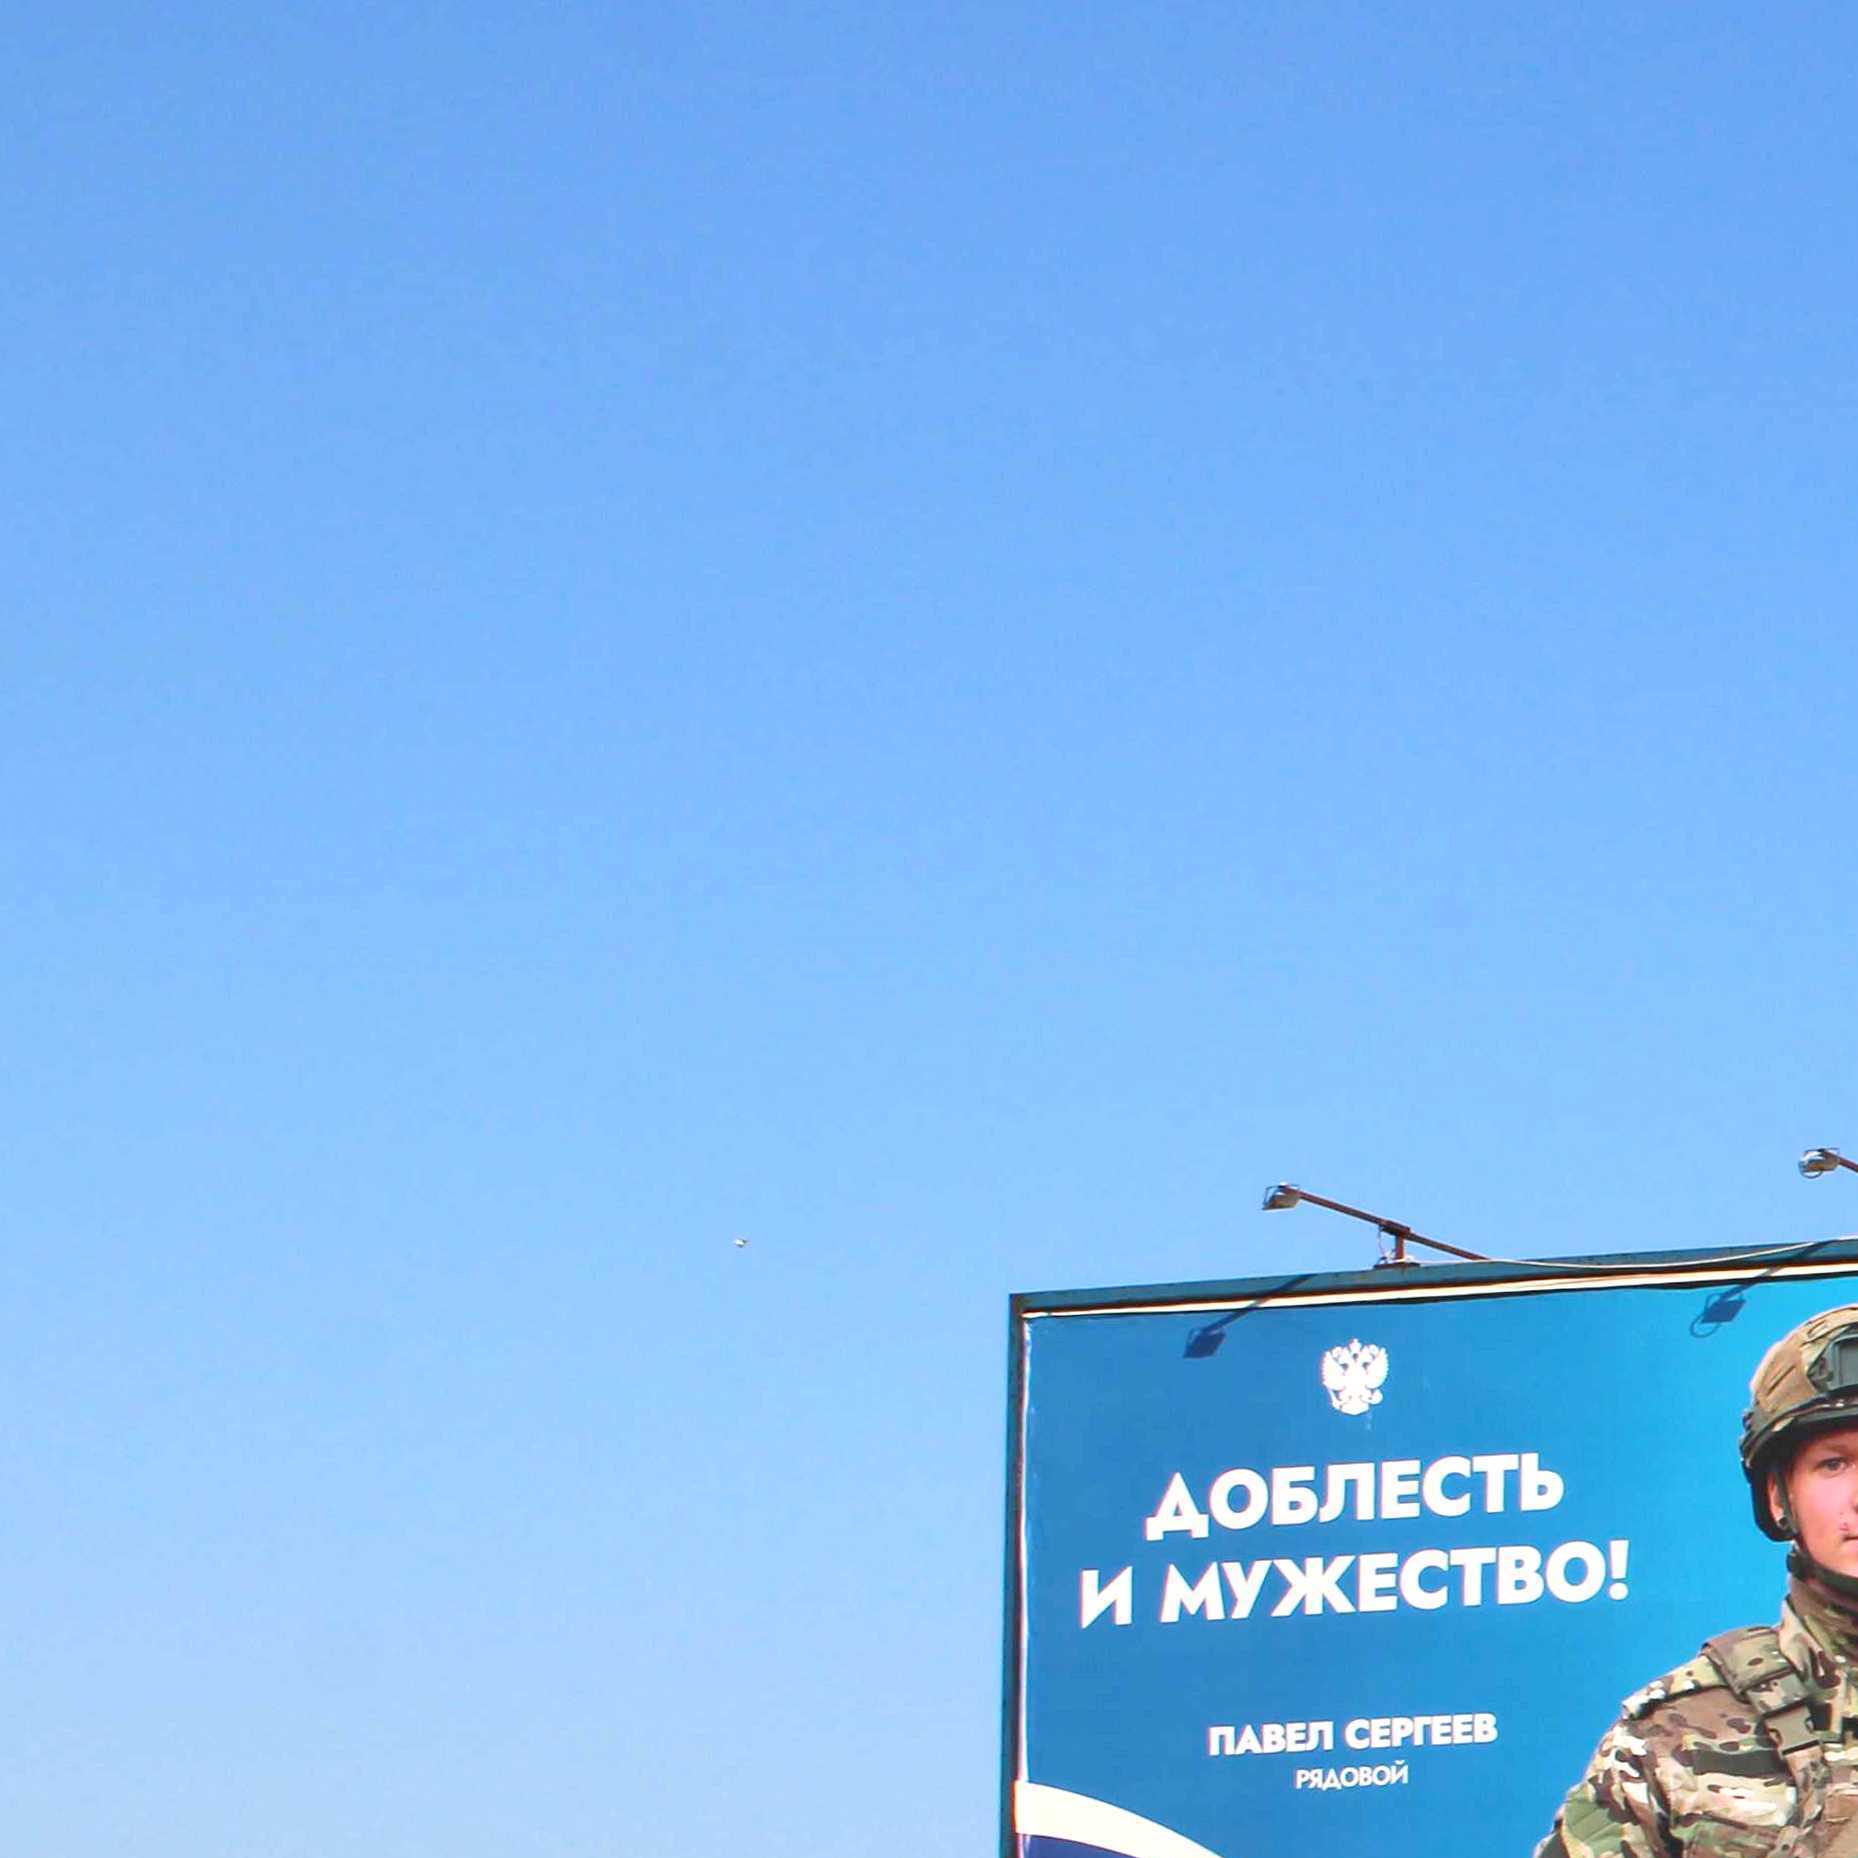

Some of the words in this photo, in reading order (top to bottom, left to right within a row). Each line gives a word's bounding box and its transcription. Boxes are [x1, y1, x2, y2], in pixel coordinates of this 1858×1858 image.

[1145, 1452, 1565, 1541] ДОБЛЕСТЬ
[1080, 1566, 1133, 1629] И
[1159, 1539, 1631, 1624] МУЖЕСТВО!
[1208, 1721, 1334, 1756] ПАВЕЛ
[1344, 1713, 1499, 1750] СЕРГЕЕВ
[1295, 1760, 1409, 1791] РЯДОВОЙ
